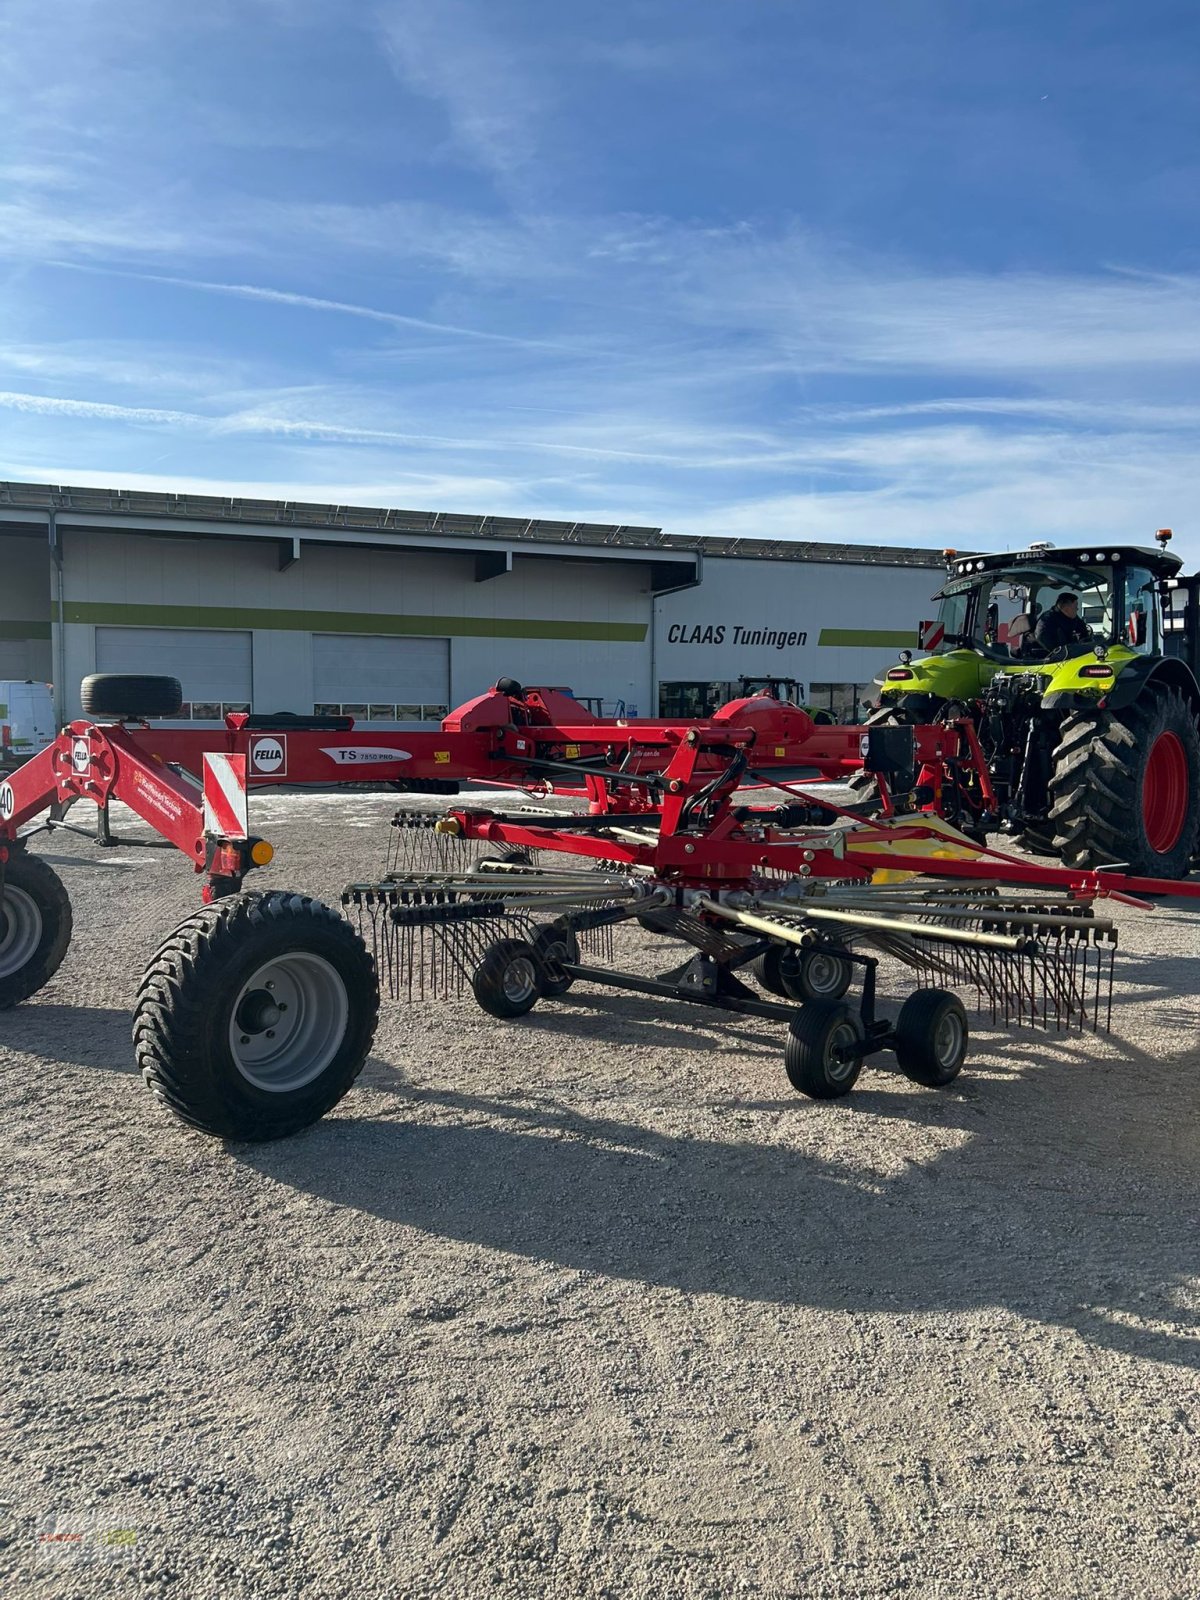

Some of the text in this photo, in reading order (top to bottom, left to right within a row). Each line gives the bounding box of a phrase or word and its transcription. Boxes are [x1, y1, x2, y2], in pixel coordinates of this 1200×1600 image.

[667, 624, 808, 650] CLAAS Tuningen
[74, 751, 87, 760] FELLA
[254, 750, 282, 760] FELLA
[338, 750, 357, 760] TS
[0, 786, 12, 815] 40
